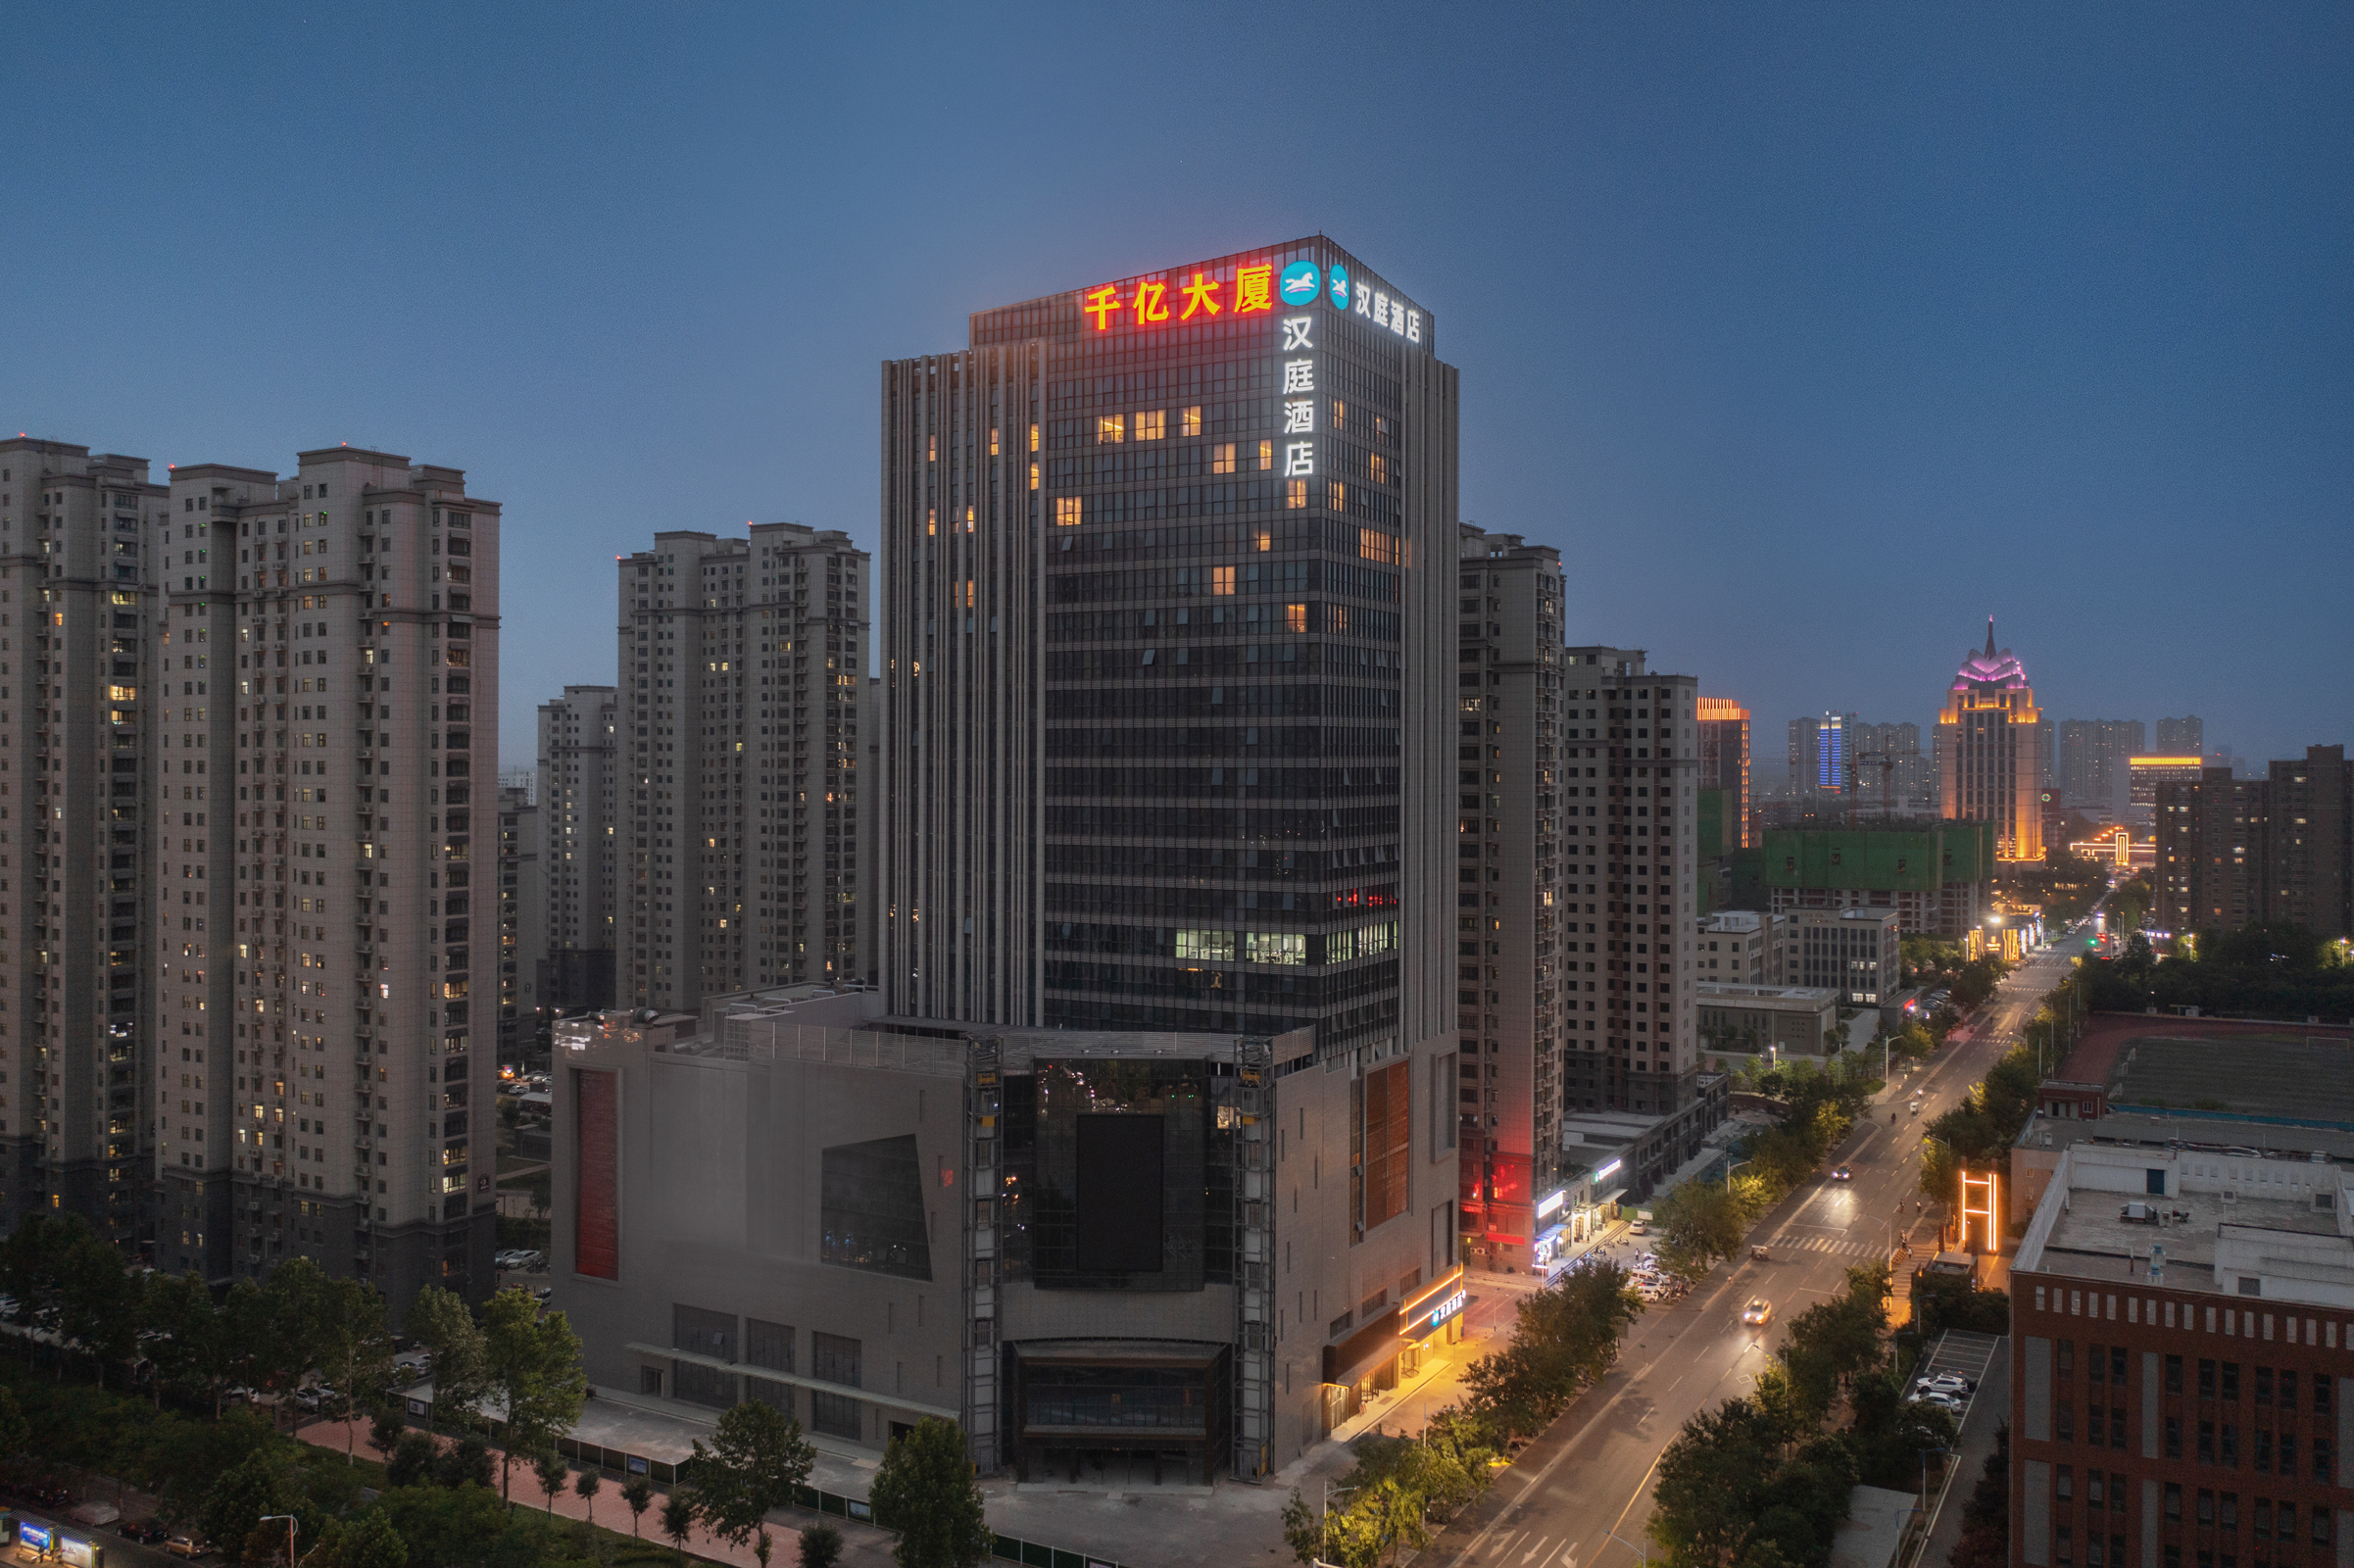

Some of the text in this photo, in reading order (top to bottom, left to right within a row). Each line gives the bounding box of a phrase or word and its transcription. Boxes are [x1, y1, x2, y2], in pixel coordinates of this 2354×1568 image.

[1085, 264, 1273, 330] 千亿大厦
[1355, 281, 1420, 343] 汉庭酒店
[1283, 317, 1314, 477] 汉庭酒店
